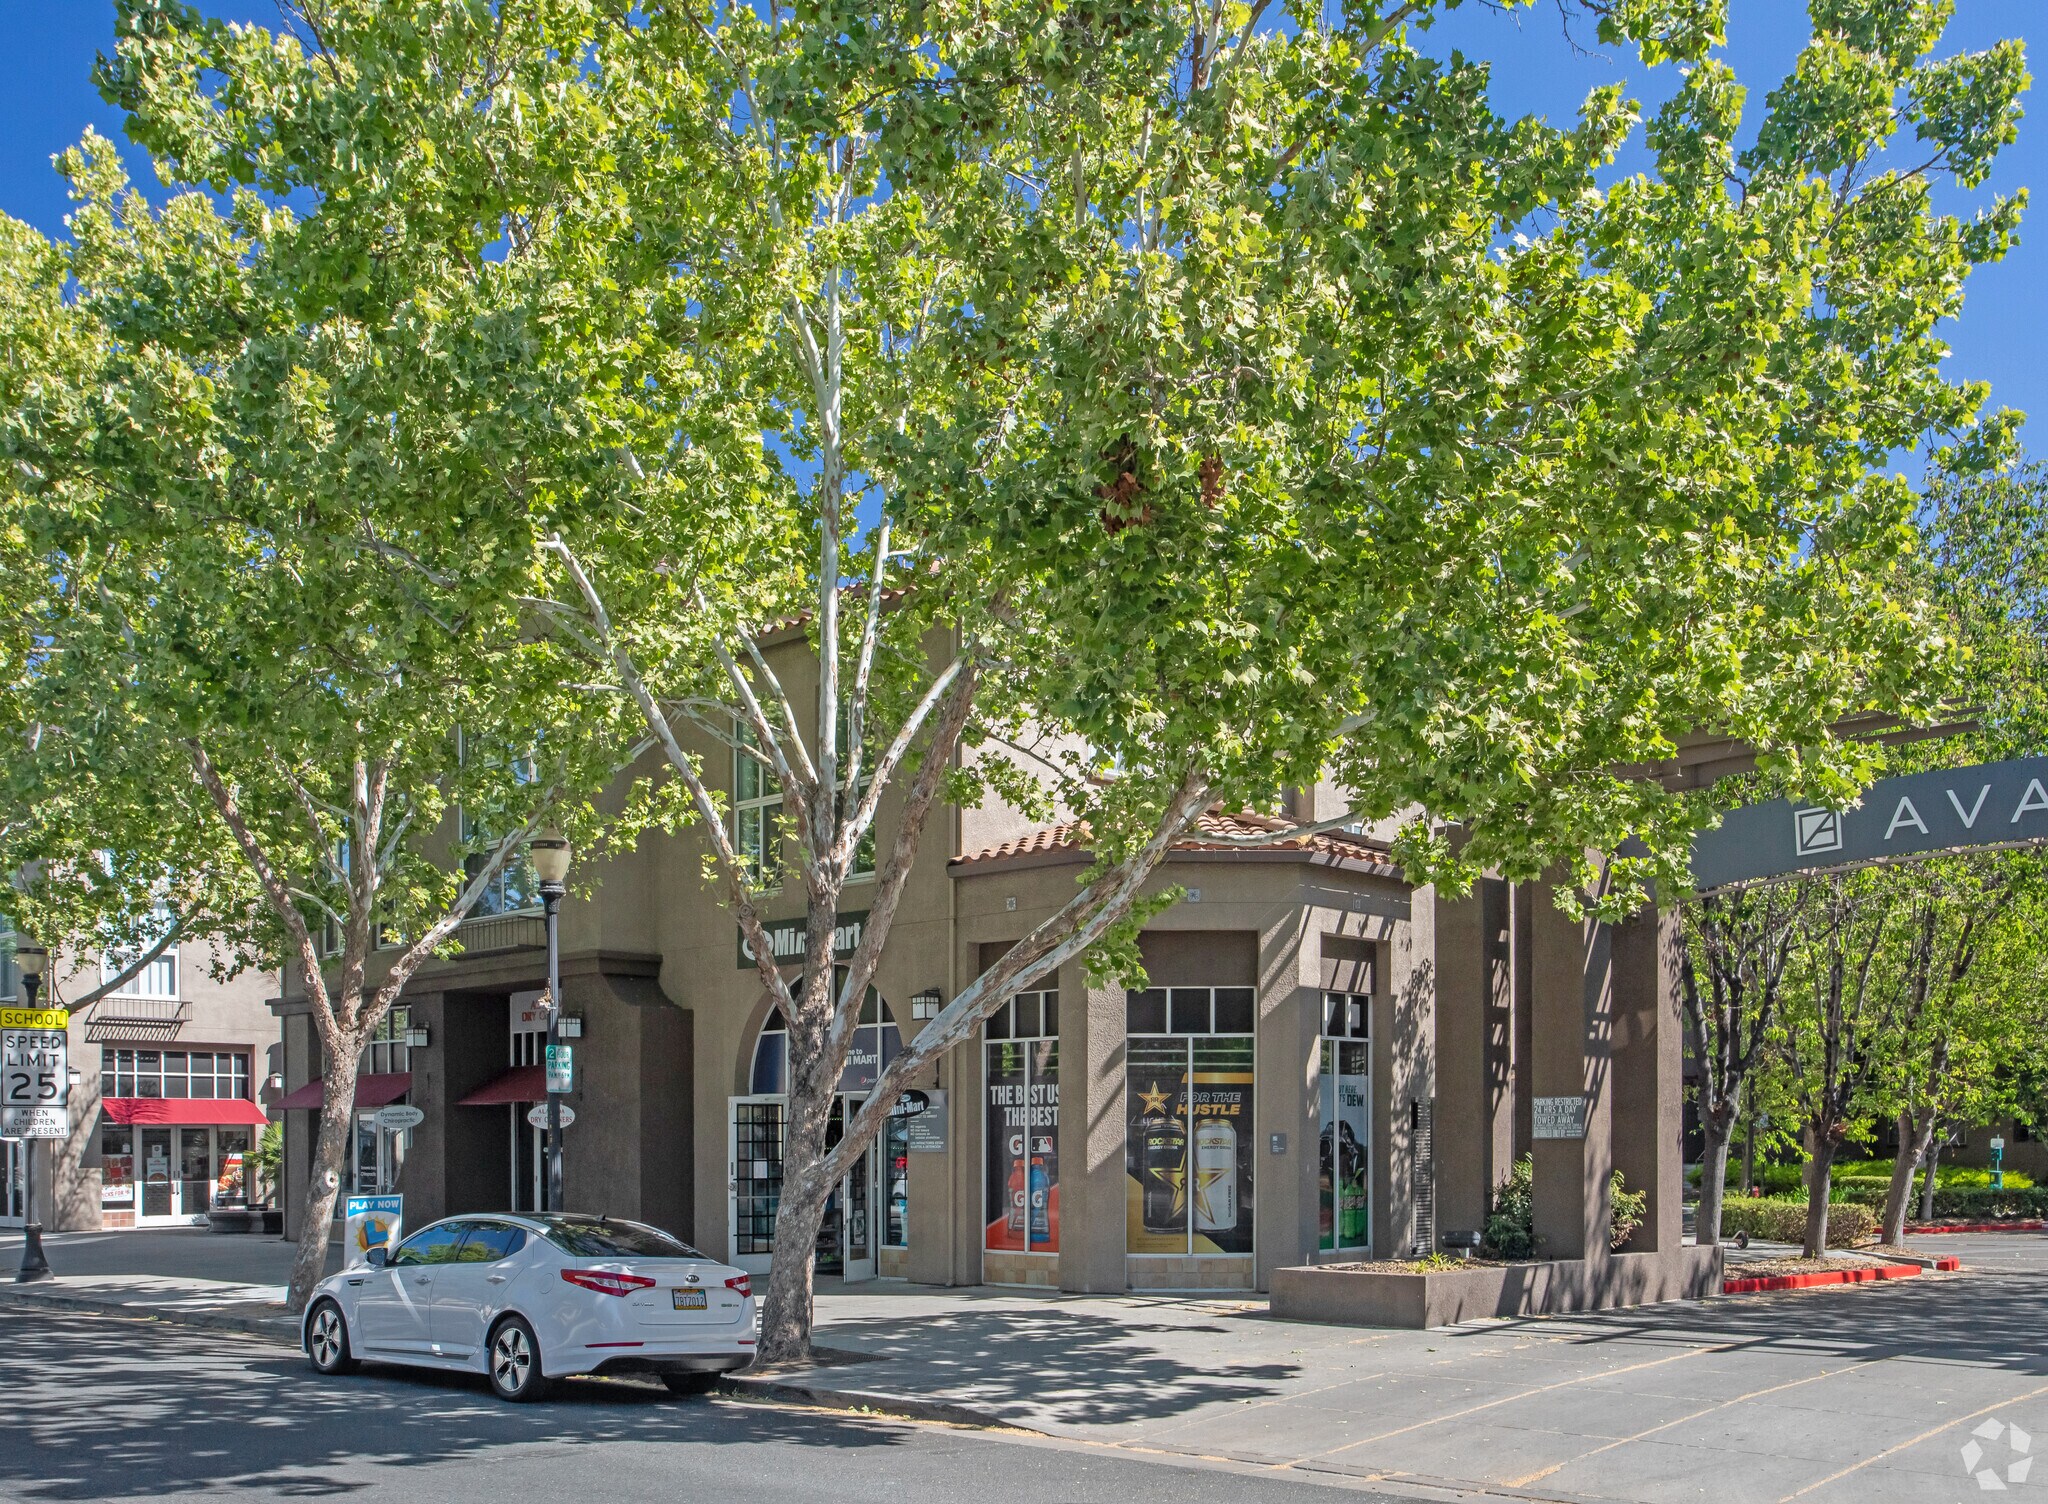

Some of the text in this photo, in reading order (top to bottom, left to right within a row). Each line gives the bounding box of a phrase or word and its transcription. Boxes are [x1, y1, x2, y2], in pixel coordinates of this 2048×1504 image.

[774, 928, 806, 956] Min
[5, 1012, 63, 1026] SCHOOL
[6, 1035, 61, 1049] SPEED
[549, 1049, 555, 1058] 2
[7, 1054, 60, 1067] LIMIT
[853, 1055, 878, 1065] MART
[548, 1062, 570, 1070] PARKING
[10, 1073, 57, 1100] 25
[990, 1085, 1013, 1105] THE
[1016, 1084, 1046, 1105] BST
[1212, 1091, 1242, 1103] THE
[1534, 1097, 1582, 1106] PARKING RESTRICTED
[21, 1109, 49, 1117] WHEN
[1176, 1104, 1241, 1115] HUSTLE
[1534, 1105, 1541, 1114] 24
[1543, 1106, 1556, 1114] HRS
[1564, 1105, 1577, 1114] DAY
[1004, 1106, 1059, 1127] THE BEST
[1534, 1116, 1575, 1124] TOWED AWAY
[13, 1118, 56, 1126] CHILDREN
[4, 1127, 65, 1135] ARE PRESENT
[1009, 1134, 1023, 1155] G
[1148, 1138, 1184, 1146] ROCKSTAR
[1032, 1190, 1043, 1208] G
[349, 1200, 399, 1210] PLAY NOW
